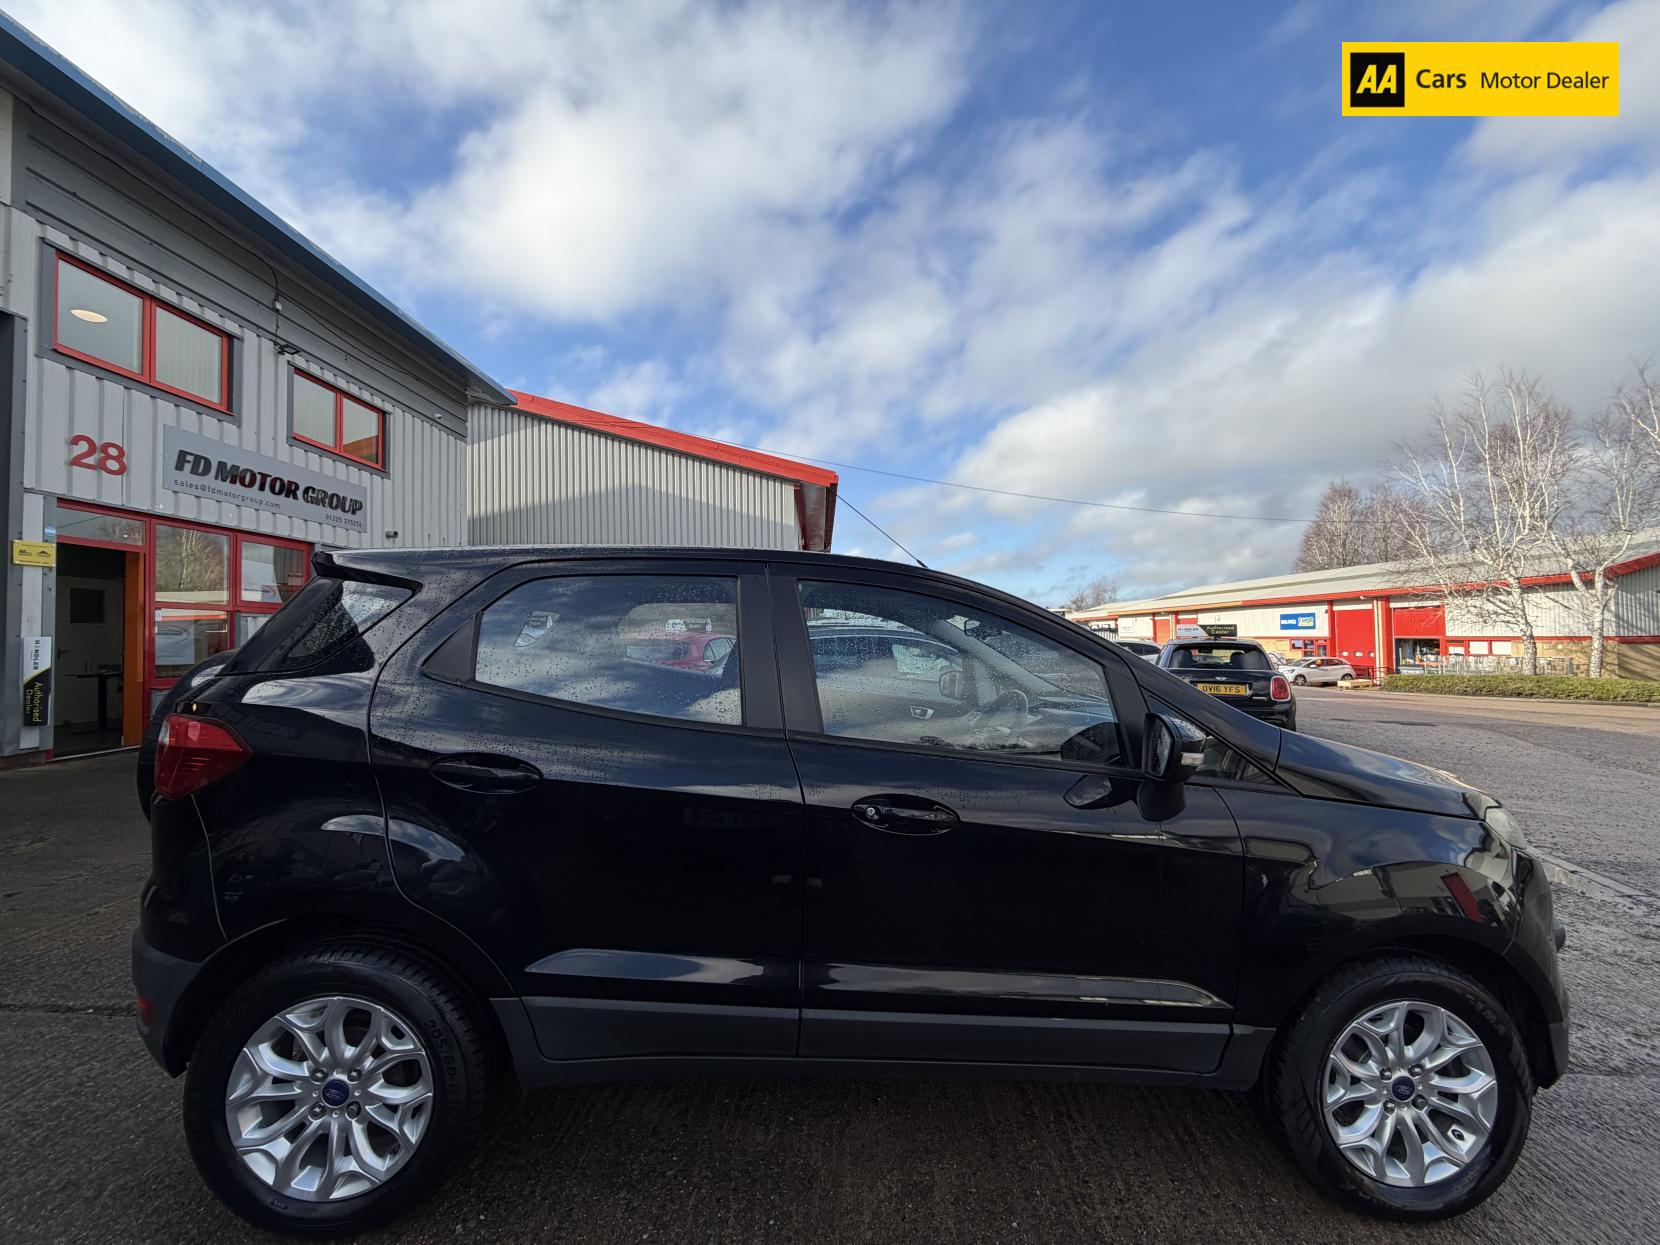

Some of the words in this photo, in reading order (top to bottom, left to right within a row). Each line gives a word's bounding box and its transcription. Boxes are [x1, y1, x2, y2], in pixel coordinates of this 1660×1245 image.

[68, 434, 127, 476] 28
[173, 478, 281, 510] sales@fdmotorgroup.com
[174, 449, 212, 477] FD
[214, 460, 300, 501] MOTOR
[302, 485, 364, 516] GROUP
[32, 681, 43, 722] Authorised
[1202, 685, 1221, 693] OV16
[1223, 685, 1241, 694] YFS
